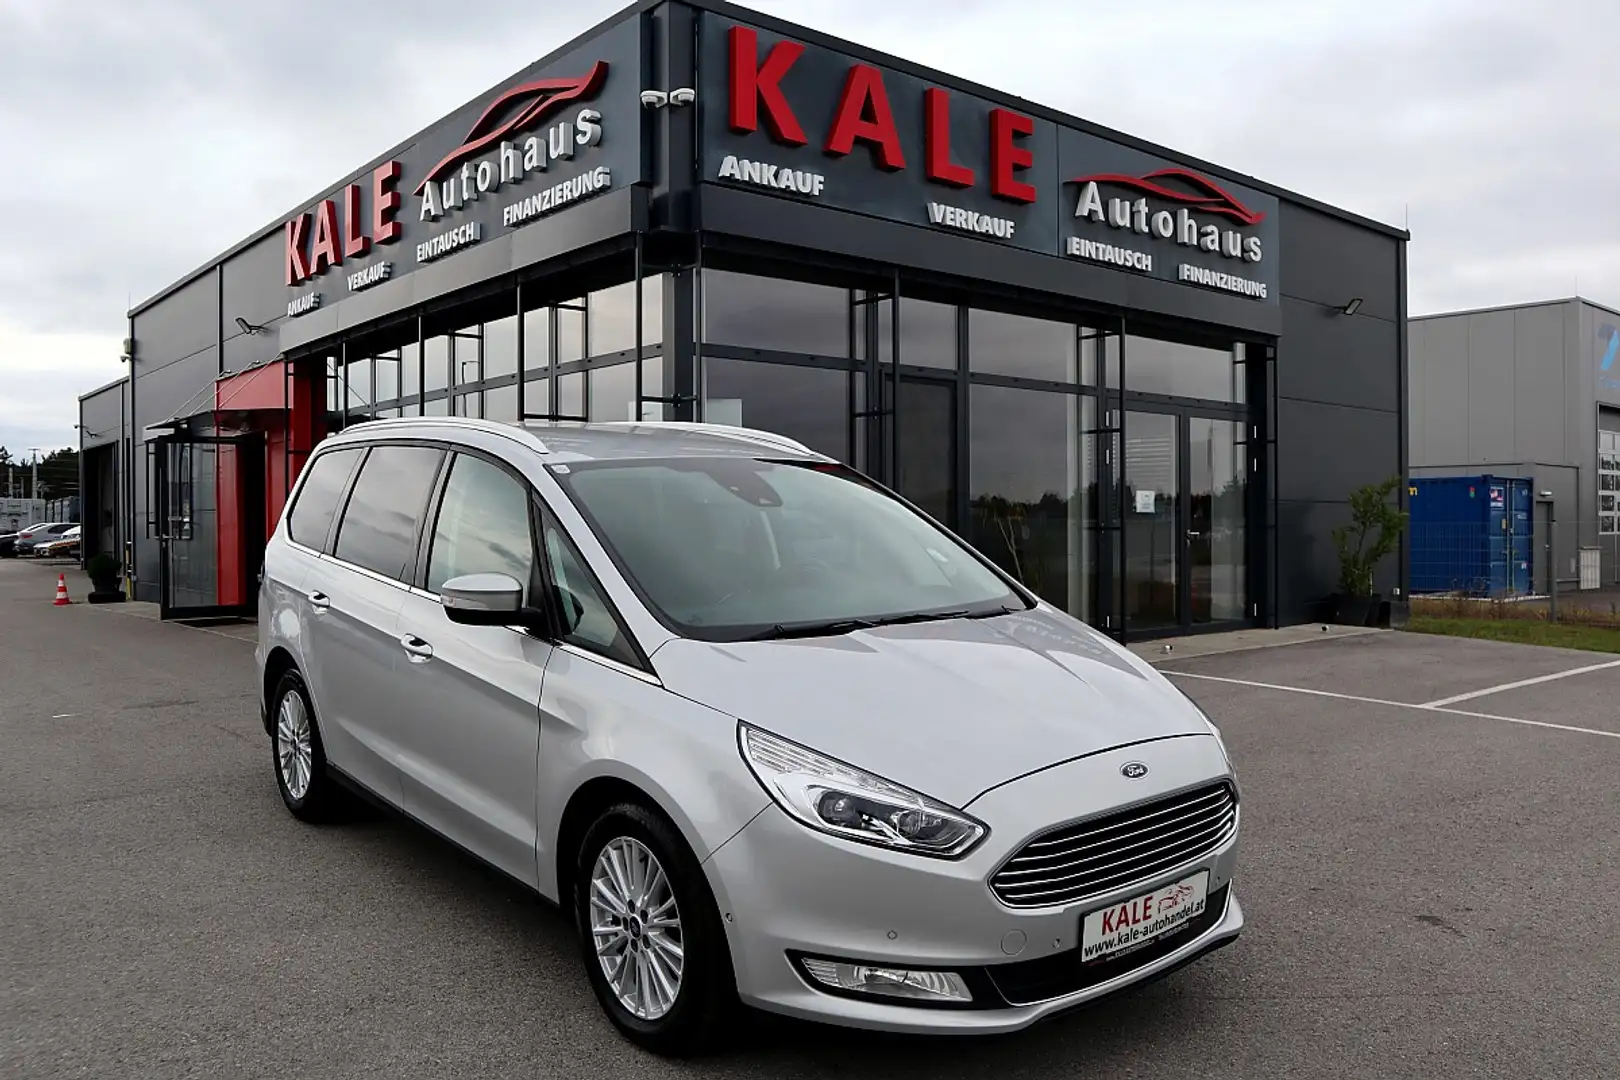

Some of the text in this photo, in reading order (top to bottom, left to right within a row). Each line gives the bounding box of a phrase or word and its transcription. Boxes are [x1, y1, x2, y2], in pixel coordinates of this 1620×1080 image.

[729, 25, 1036, 203] KALE
[420, 109, 602, 222] Autohaus
[718, 155, 825, 197] ANKAUF
[503, 166, 611, 228] FINANZIERUNG
[285, 160, 400, 287] KALE
[926, 202, 1015, 239] VERKAUF
[1075, 180, 1262, 262] Autohaus
[416, 221, 481, 263] EINTAUSCH
[1066, 236, 1152, 272] EINTAUSCH
[347, 260, 392, 292] VERKAUF
[1178, 263, 1267, 299] FINANZIERUNG
[1083, 898, 1204, 957] www.kale-autohandel.at
[1101, 895, 1153, 936] KALE
